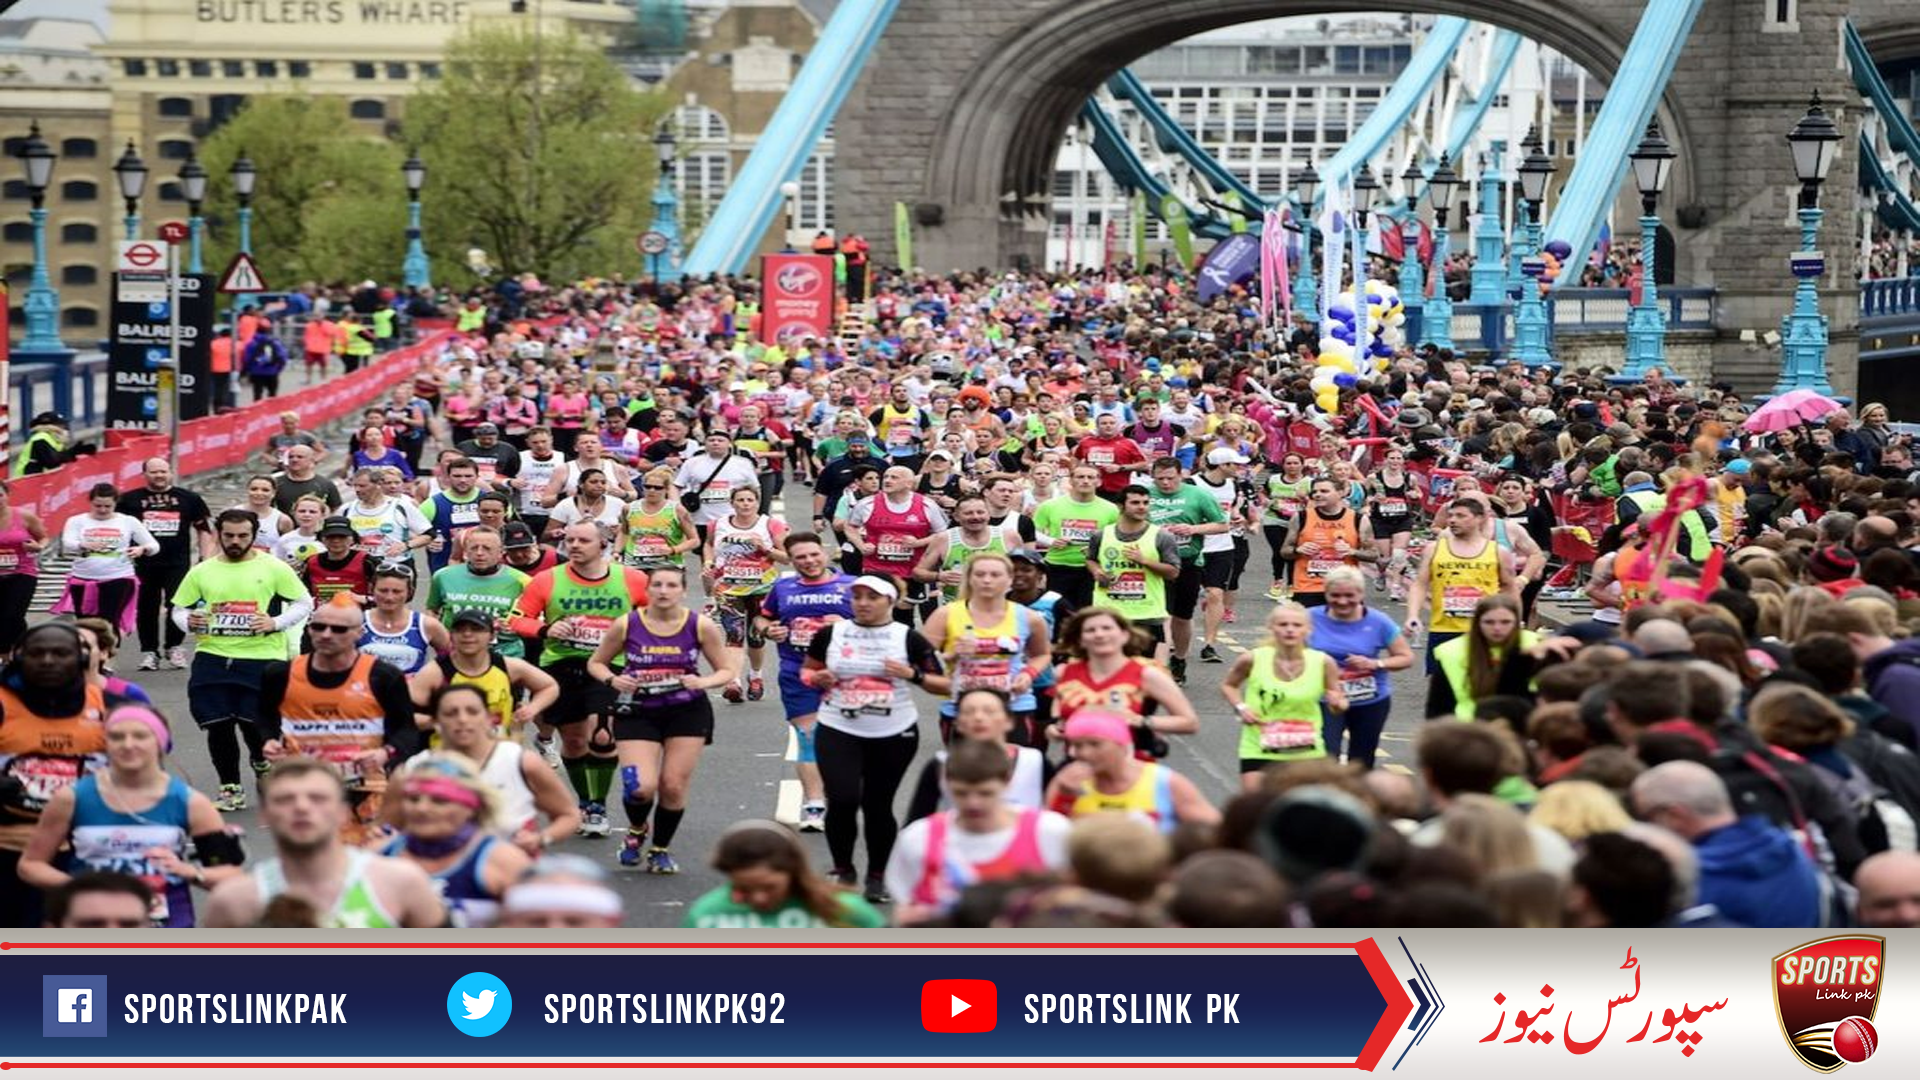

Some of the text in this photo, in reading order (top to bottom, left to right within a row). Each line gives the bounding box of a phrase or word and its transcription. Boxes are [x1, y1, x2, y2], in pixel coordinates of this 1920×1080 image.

[197, 1, 470, 24] BUTLERS WHARF
[165, 226, 183, 238] TL
[559, 597, 622, 610] YMCA
[787, 594, 843, 605] PATRICK
